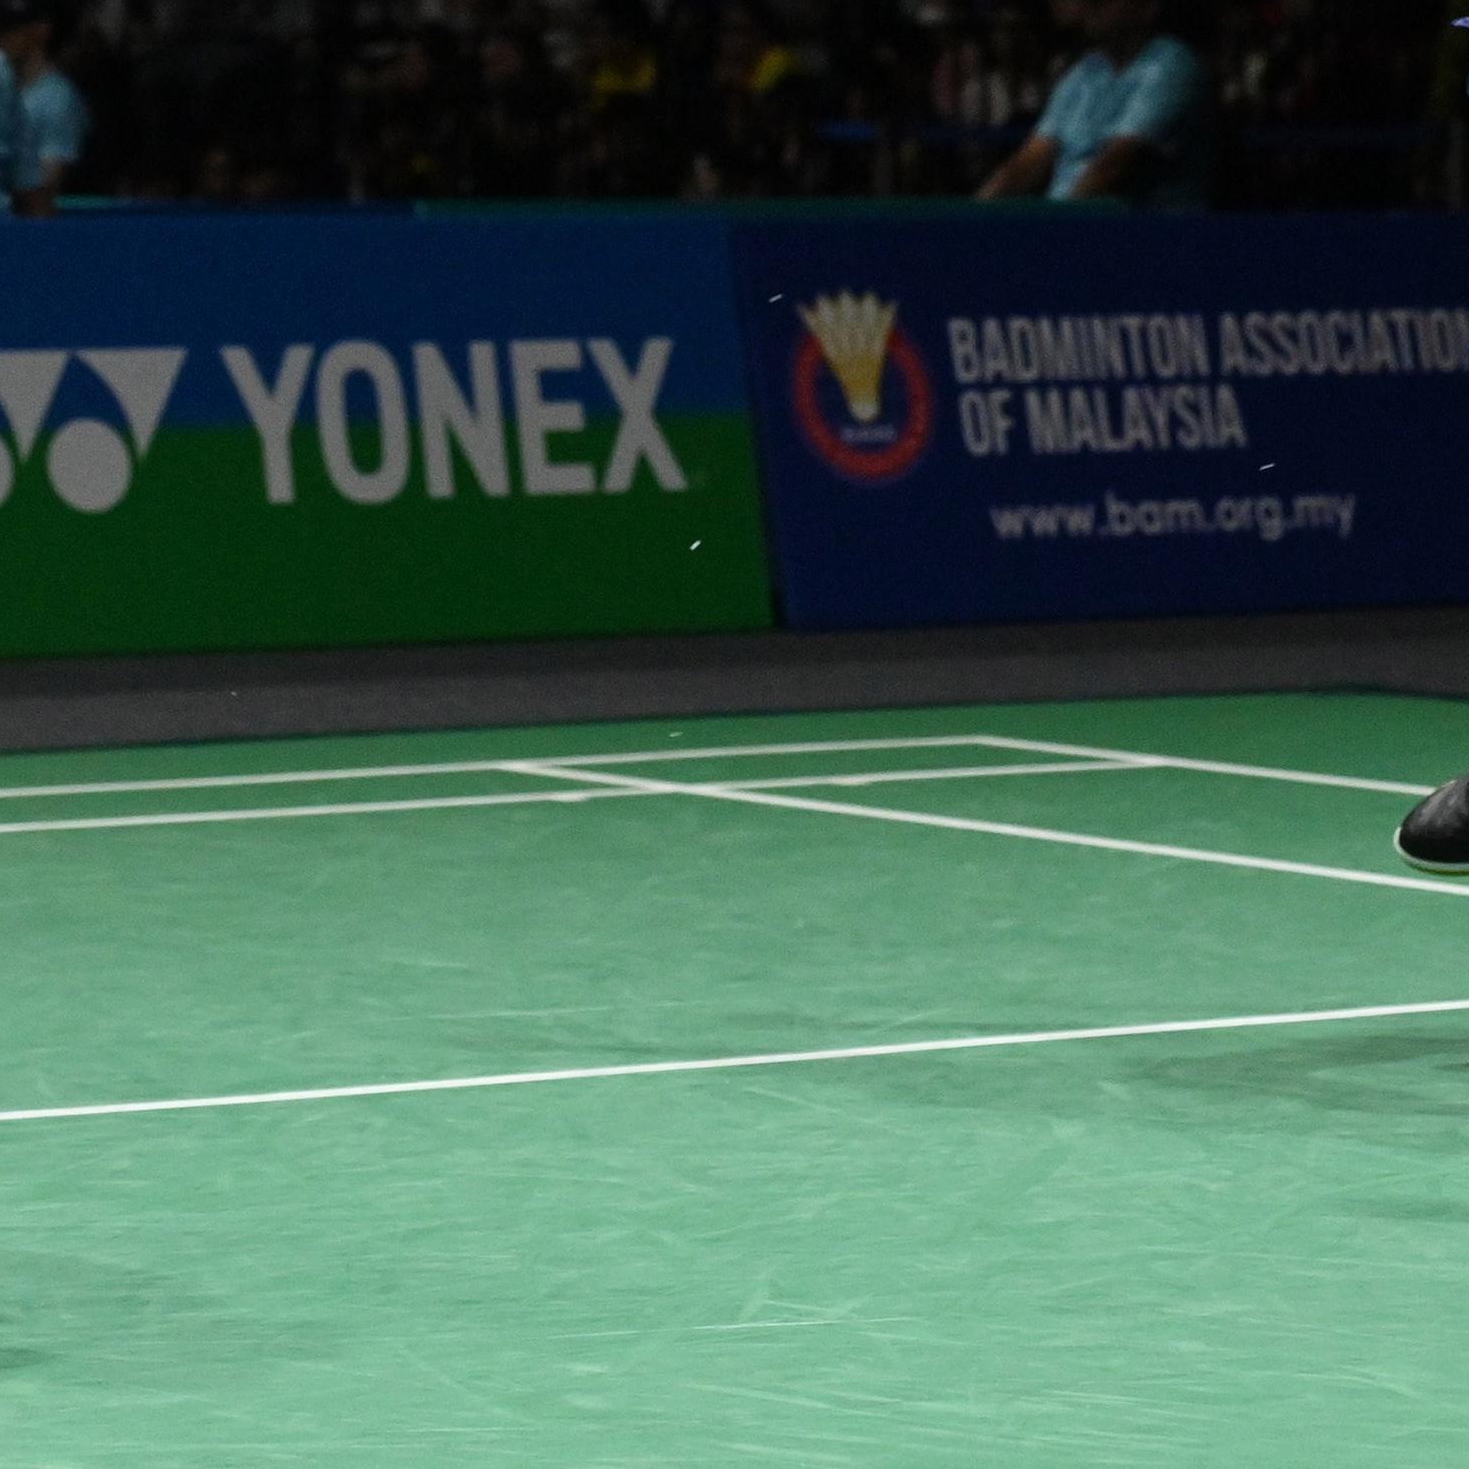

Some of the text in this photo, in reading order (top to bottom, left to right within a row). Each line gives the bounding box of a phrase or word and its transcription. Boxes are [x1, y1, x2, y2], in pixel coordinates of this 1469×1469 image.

[947, 312, 1211, 383] BADMINTON
[219, 337, 689, 505] YONEX
[958, 384, 1249, 457] OF MALAYSIA
[989, 490, 1357, 541] www.bam.org.my
